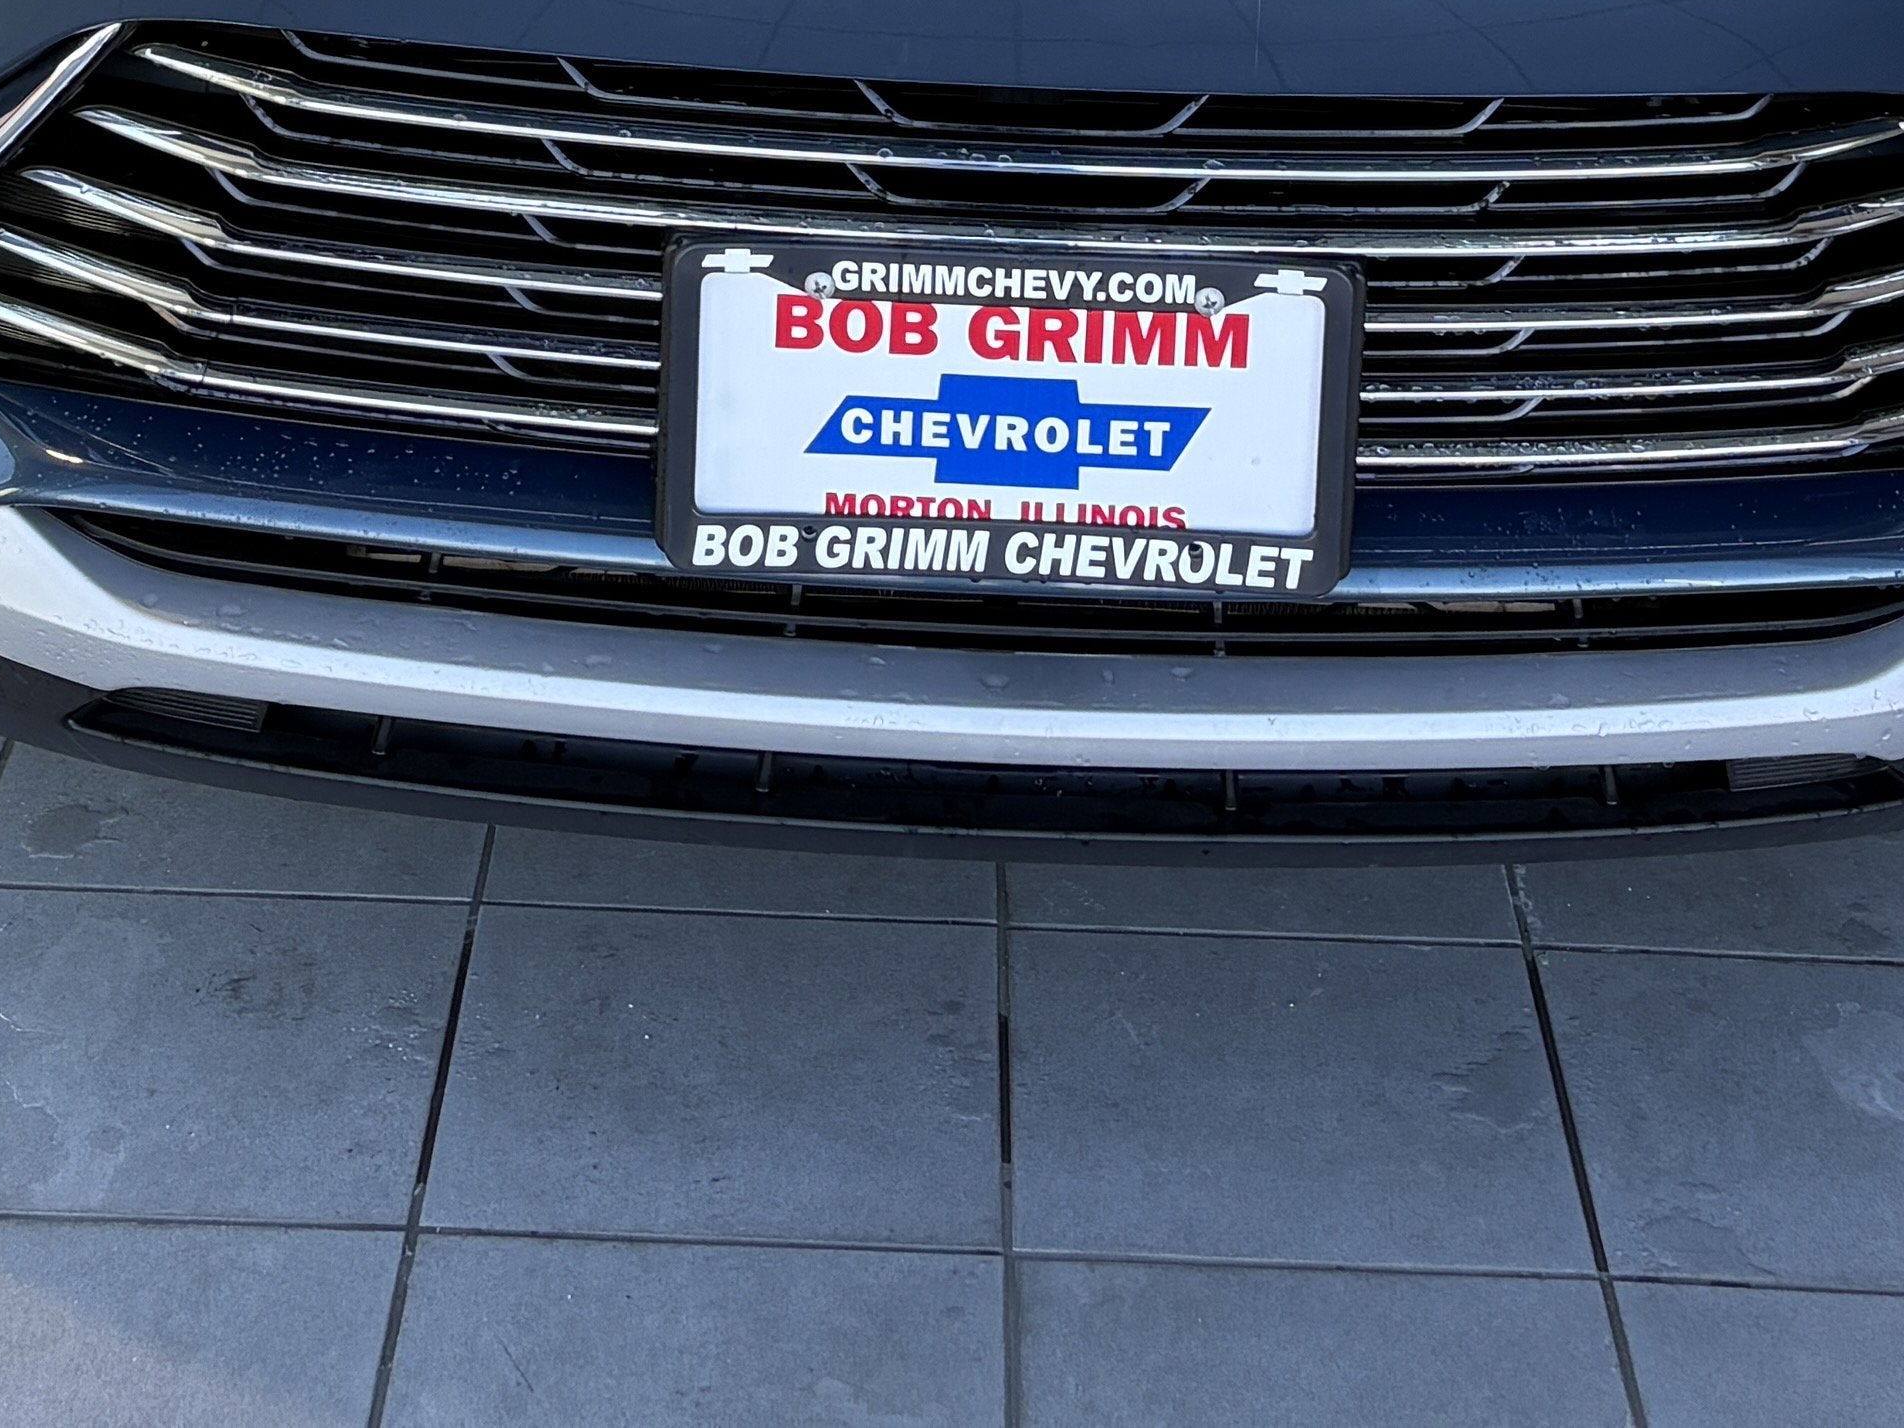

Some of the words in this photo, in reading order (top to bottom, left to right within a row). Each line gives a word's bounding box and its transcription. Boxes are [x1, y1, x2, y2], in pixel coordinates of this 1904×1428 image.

[831, 260, 1197, 305] GRIMMCHEVY.COM
[774, 294, 940, 356] BOB
[968, 305, 1251, 370] GRIMM
[841, 407, 1171, 458] CHEVROLET
[692, 524, 799, 569] BOB
[815, 526, 990, 574] GRIMM
[1004, 531, 1313, 591] CHEVROLET
